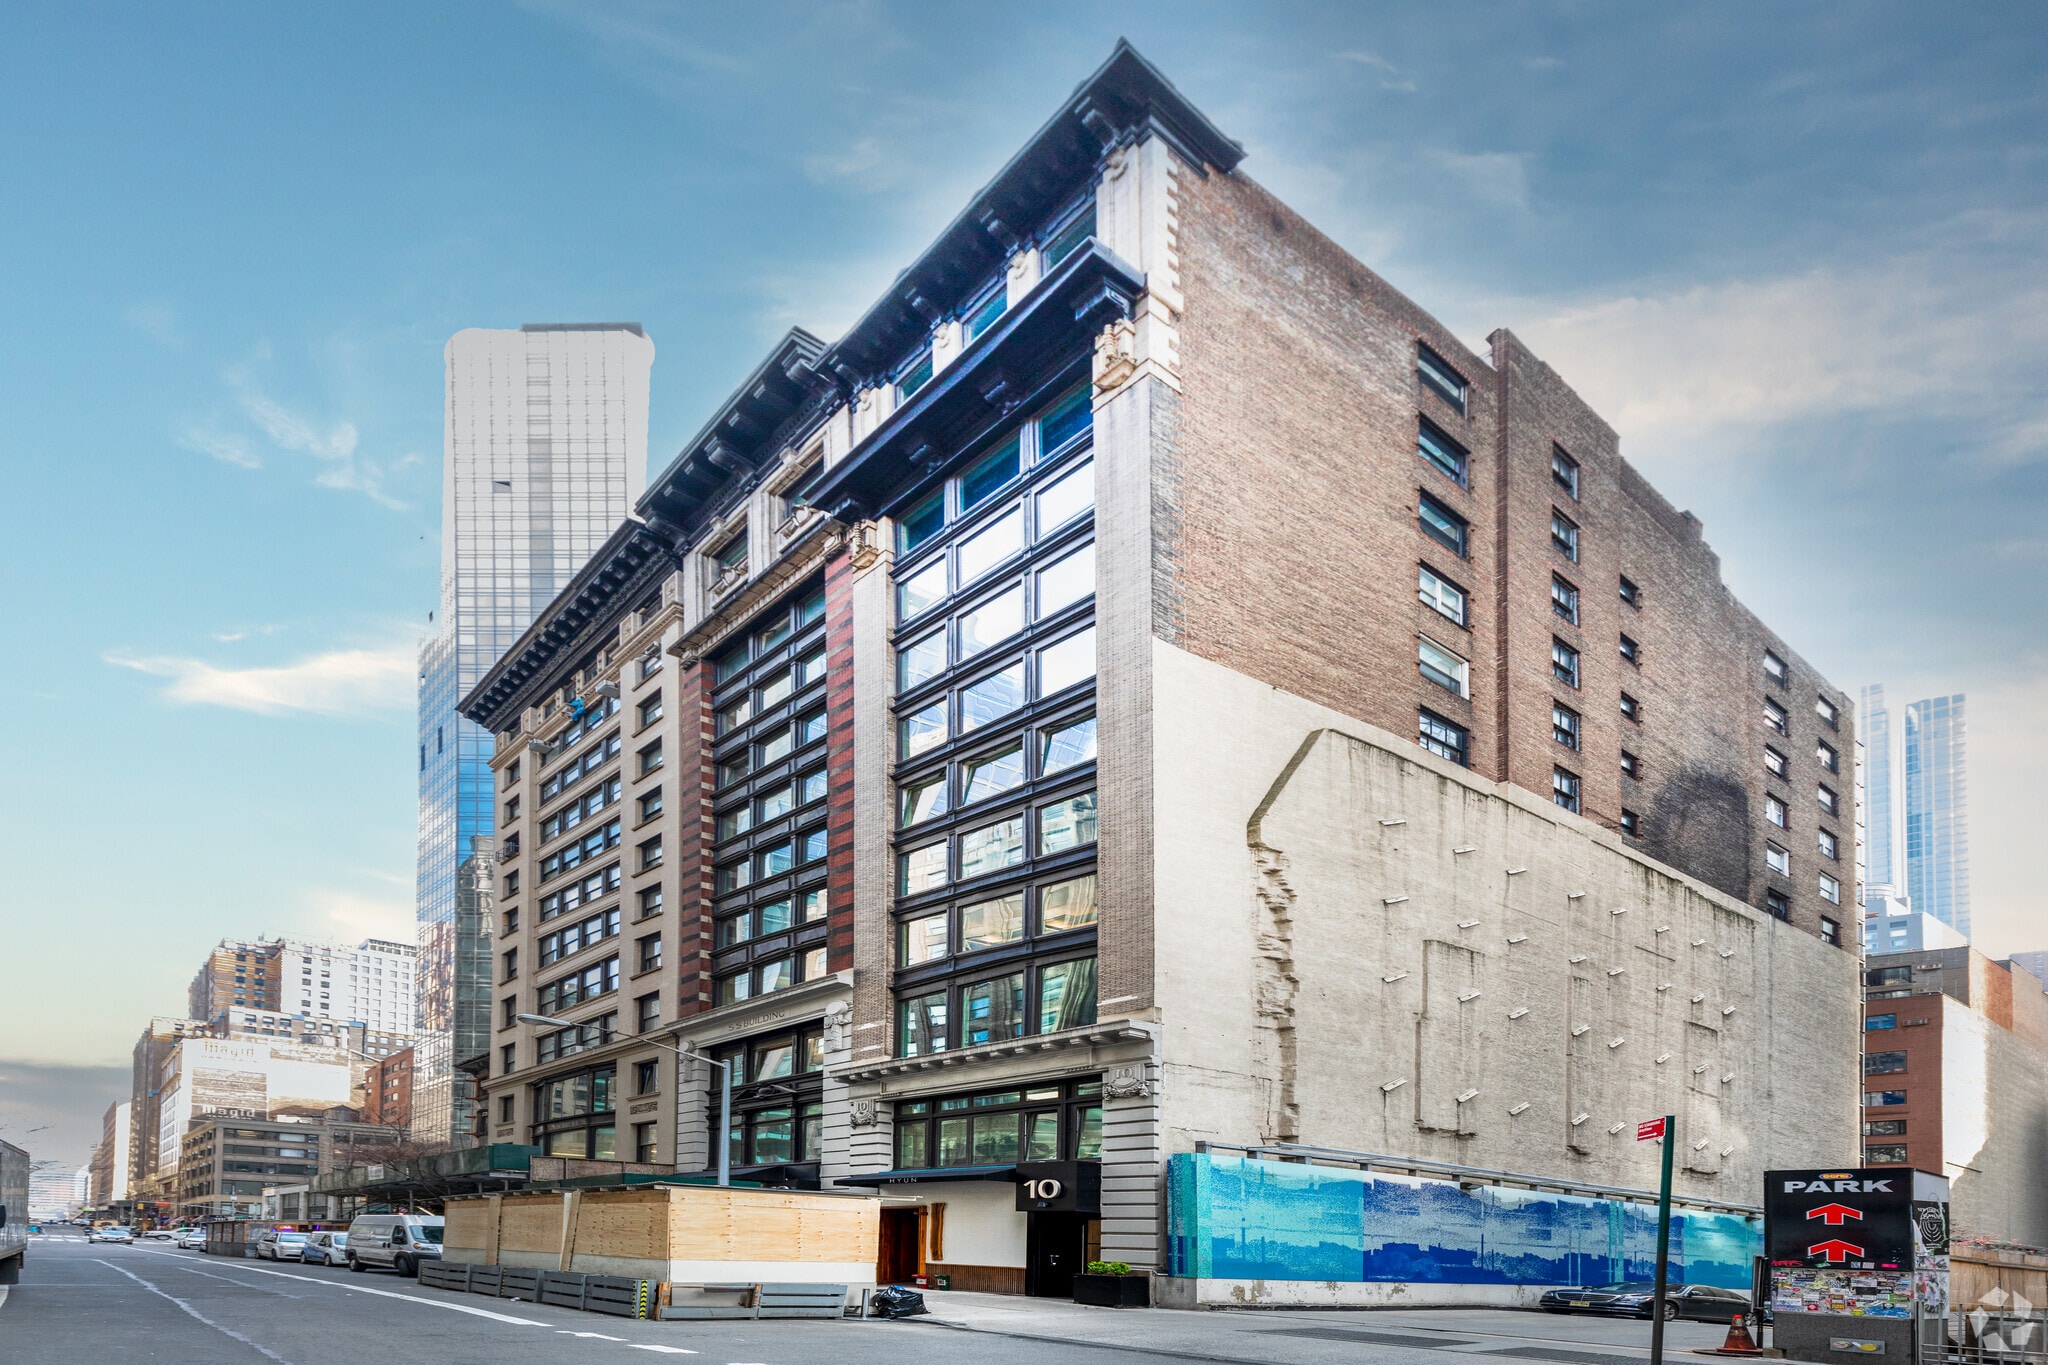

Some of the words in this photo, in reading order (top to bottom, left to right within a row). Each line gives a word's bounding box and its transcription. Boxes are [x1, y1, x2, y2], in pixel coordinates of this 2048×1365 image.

[743, 1009, 785, 1027] BUILDING
[1115, 1067, 1133, 1079] 10
[857, 1101, 868, 1111] 10
[1023, 1178, 1062, 1199] 10
[1783, 1179, 1894, 1194] PARK
